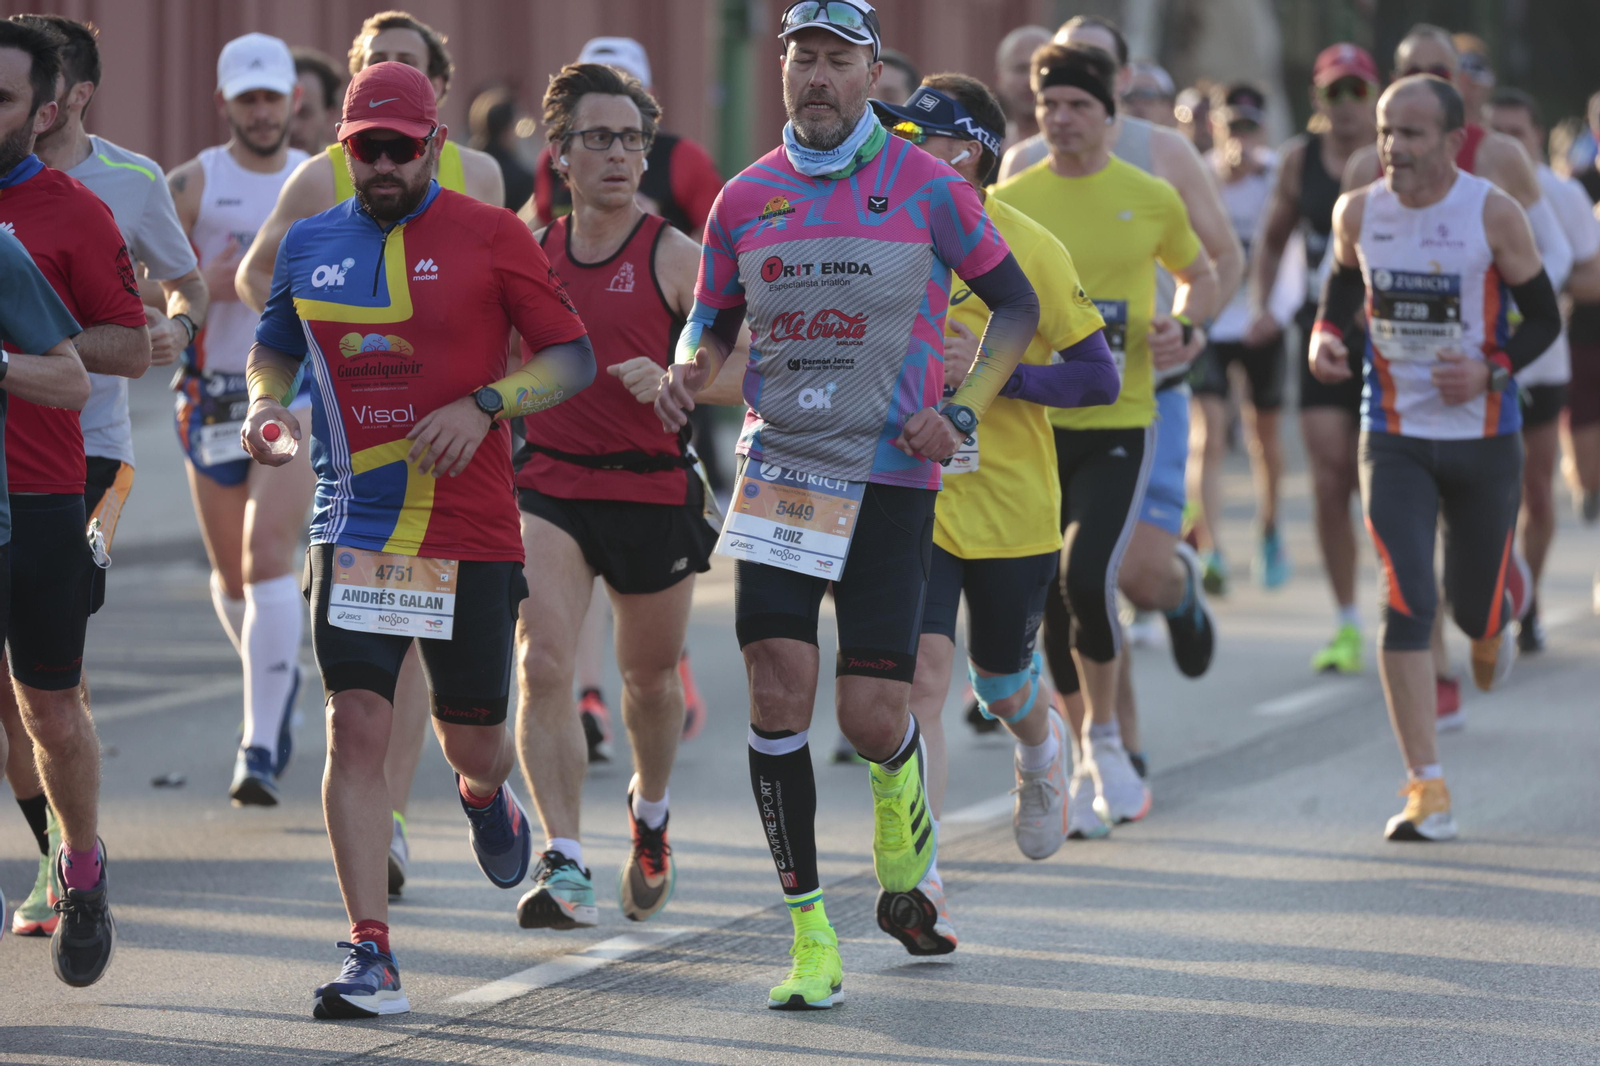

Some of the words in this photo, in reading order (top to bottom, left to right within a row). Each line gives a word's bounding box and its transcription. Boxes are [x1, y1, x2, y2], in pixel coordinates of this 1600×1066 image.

[769, 280, 818, 291] Especialista
[821, 279, 851, 287] triatlón
[1393, 274, 1450, 292] ZURICH
[337, 361, 423, 379] Guadalquivir
[351, 403, 414, 424] Visol
[775, 500, 815, 521] 5449
[772, 526, 804, 544] RUIZ
[735, 541, 755, 550] asics
[375, 564, 413, 582] 4751
[341, 589, 395, 605] ANDRÉS
[400, 594, 444, 610] GALAN
